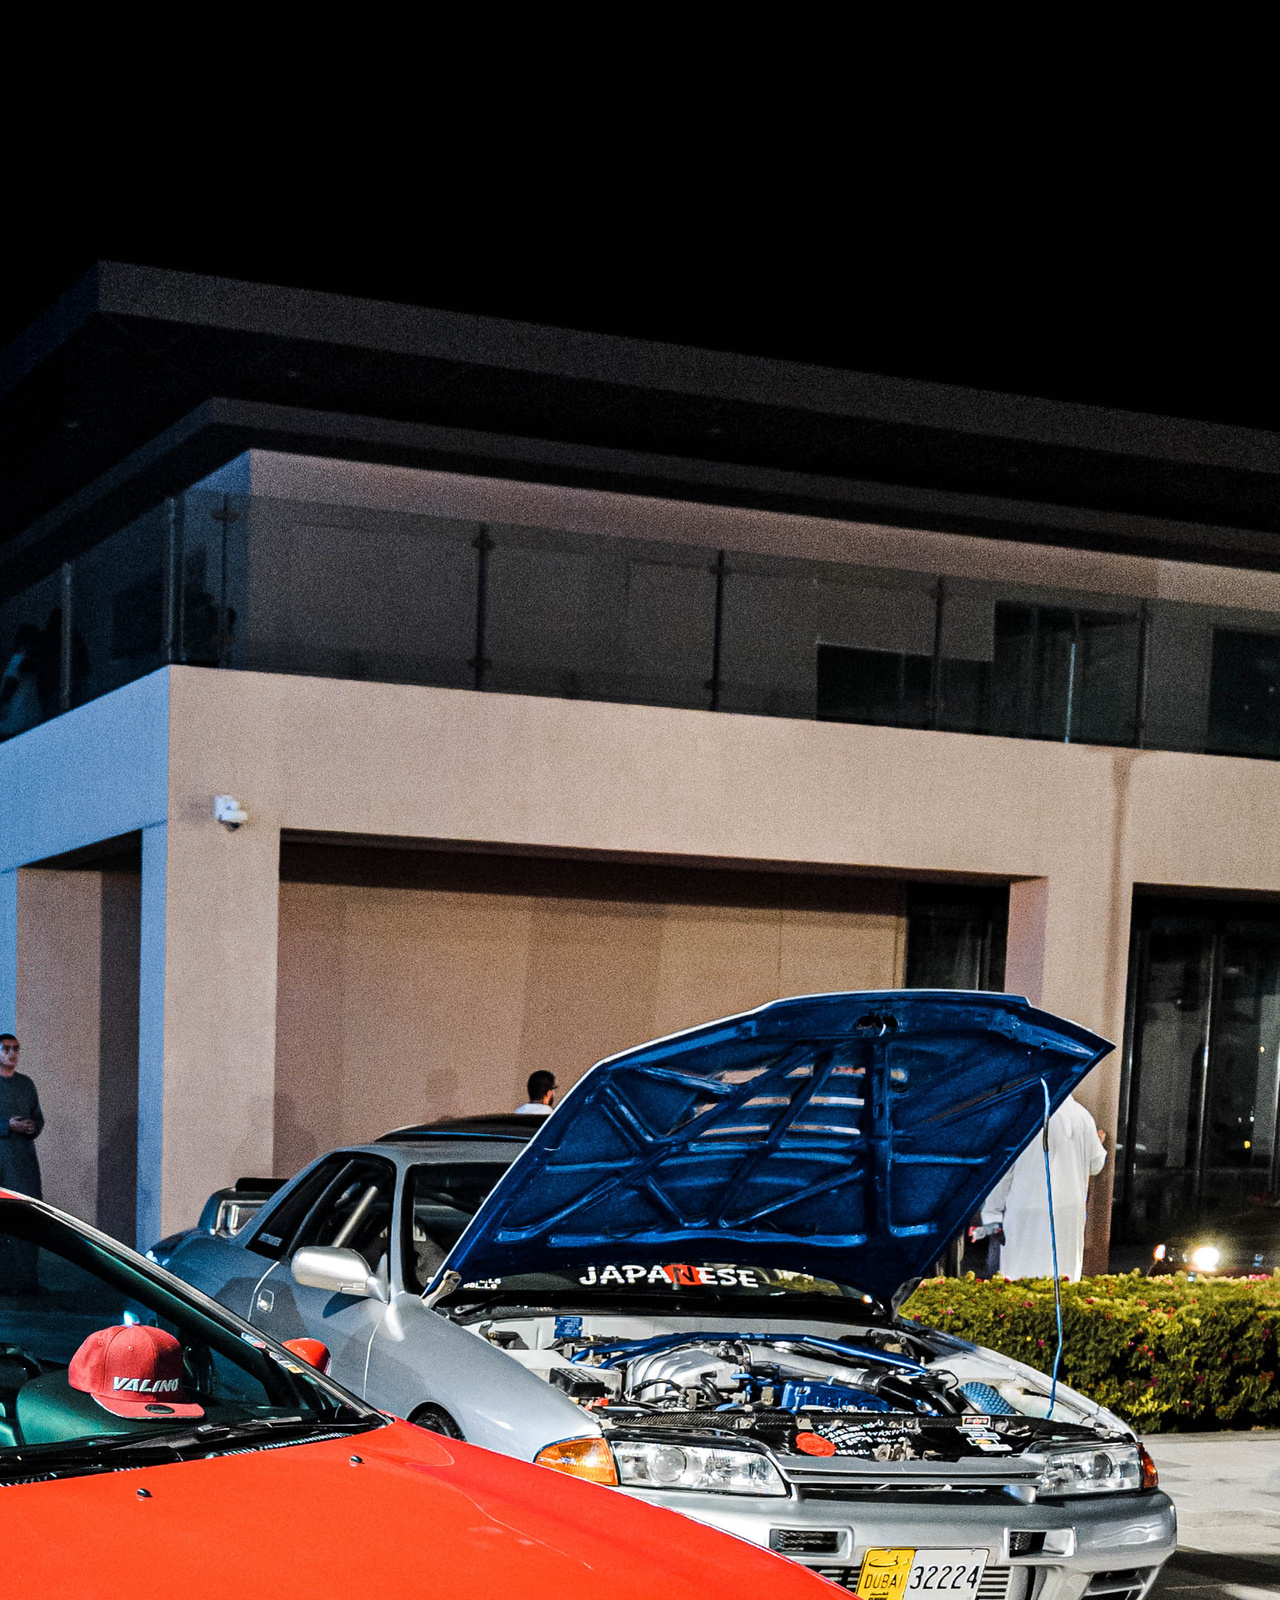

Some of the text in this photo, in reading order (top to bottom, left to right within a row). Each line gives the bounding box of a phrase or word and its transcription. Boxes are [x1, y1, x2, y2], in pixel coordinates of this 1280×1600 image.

[579, 1264, 759, 1288] JAPANESE
[113, 1376, 179, 1392] VALINO
[864, 1573, 904, 1589] DUBAI
[909, 1565, 980, 1590] 32224
